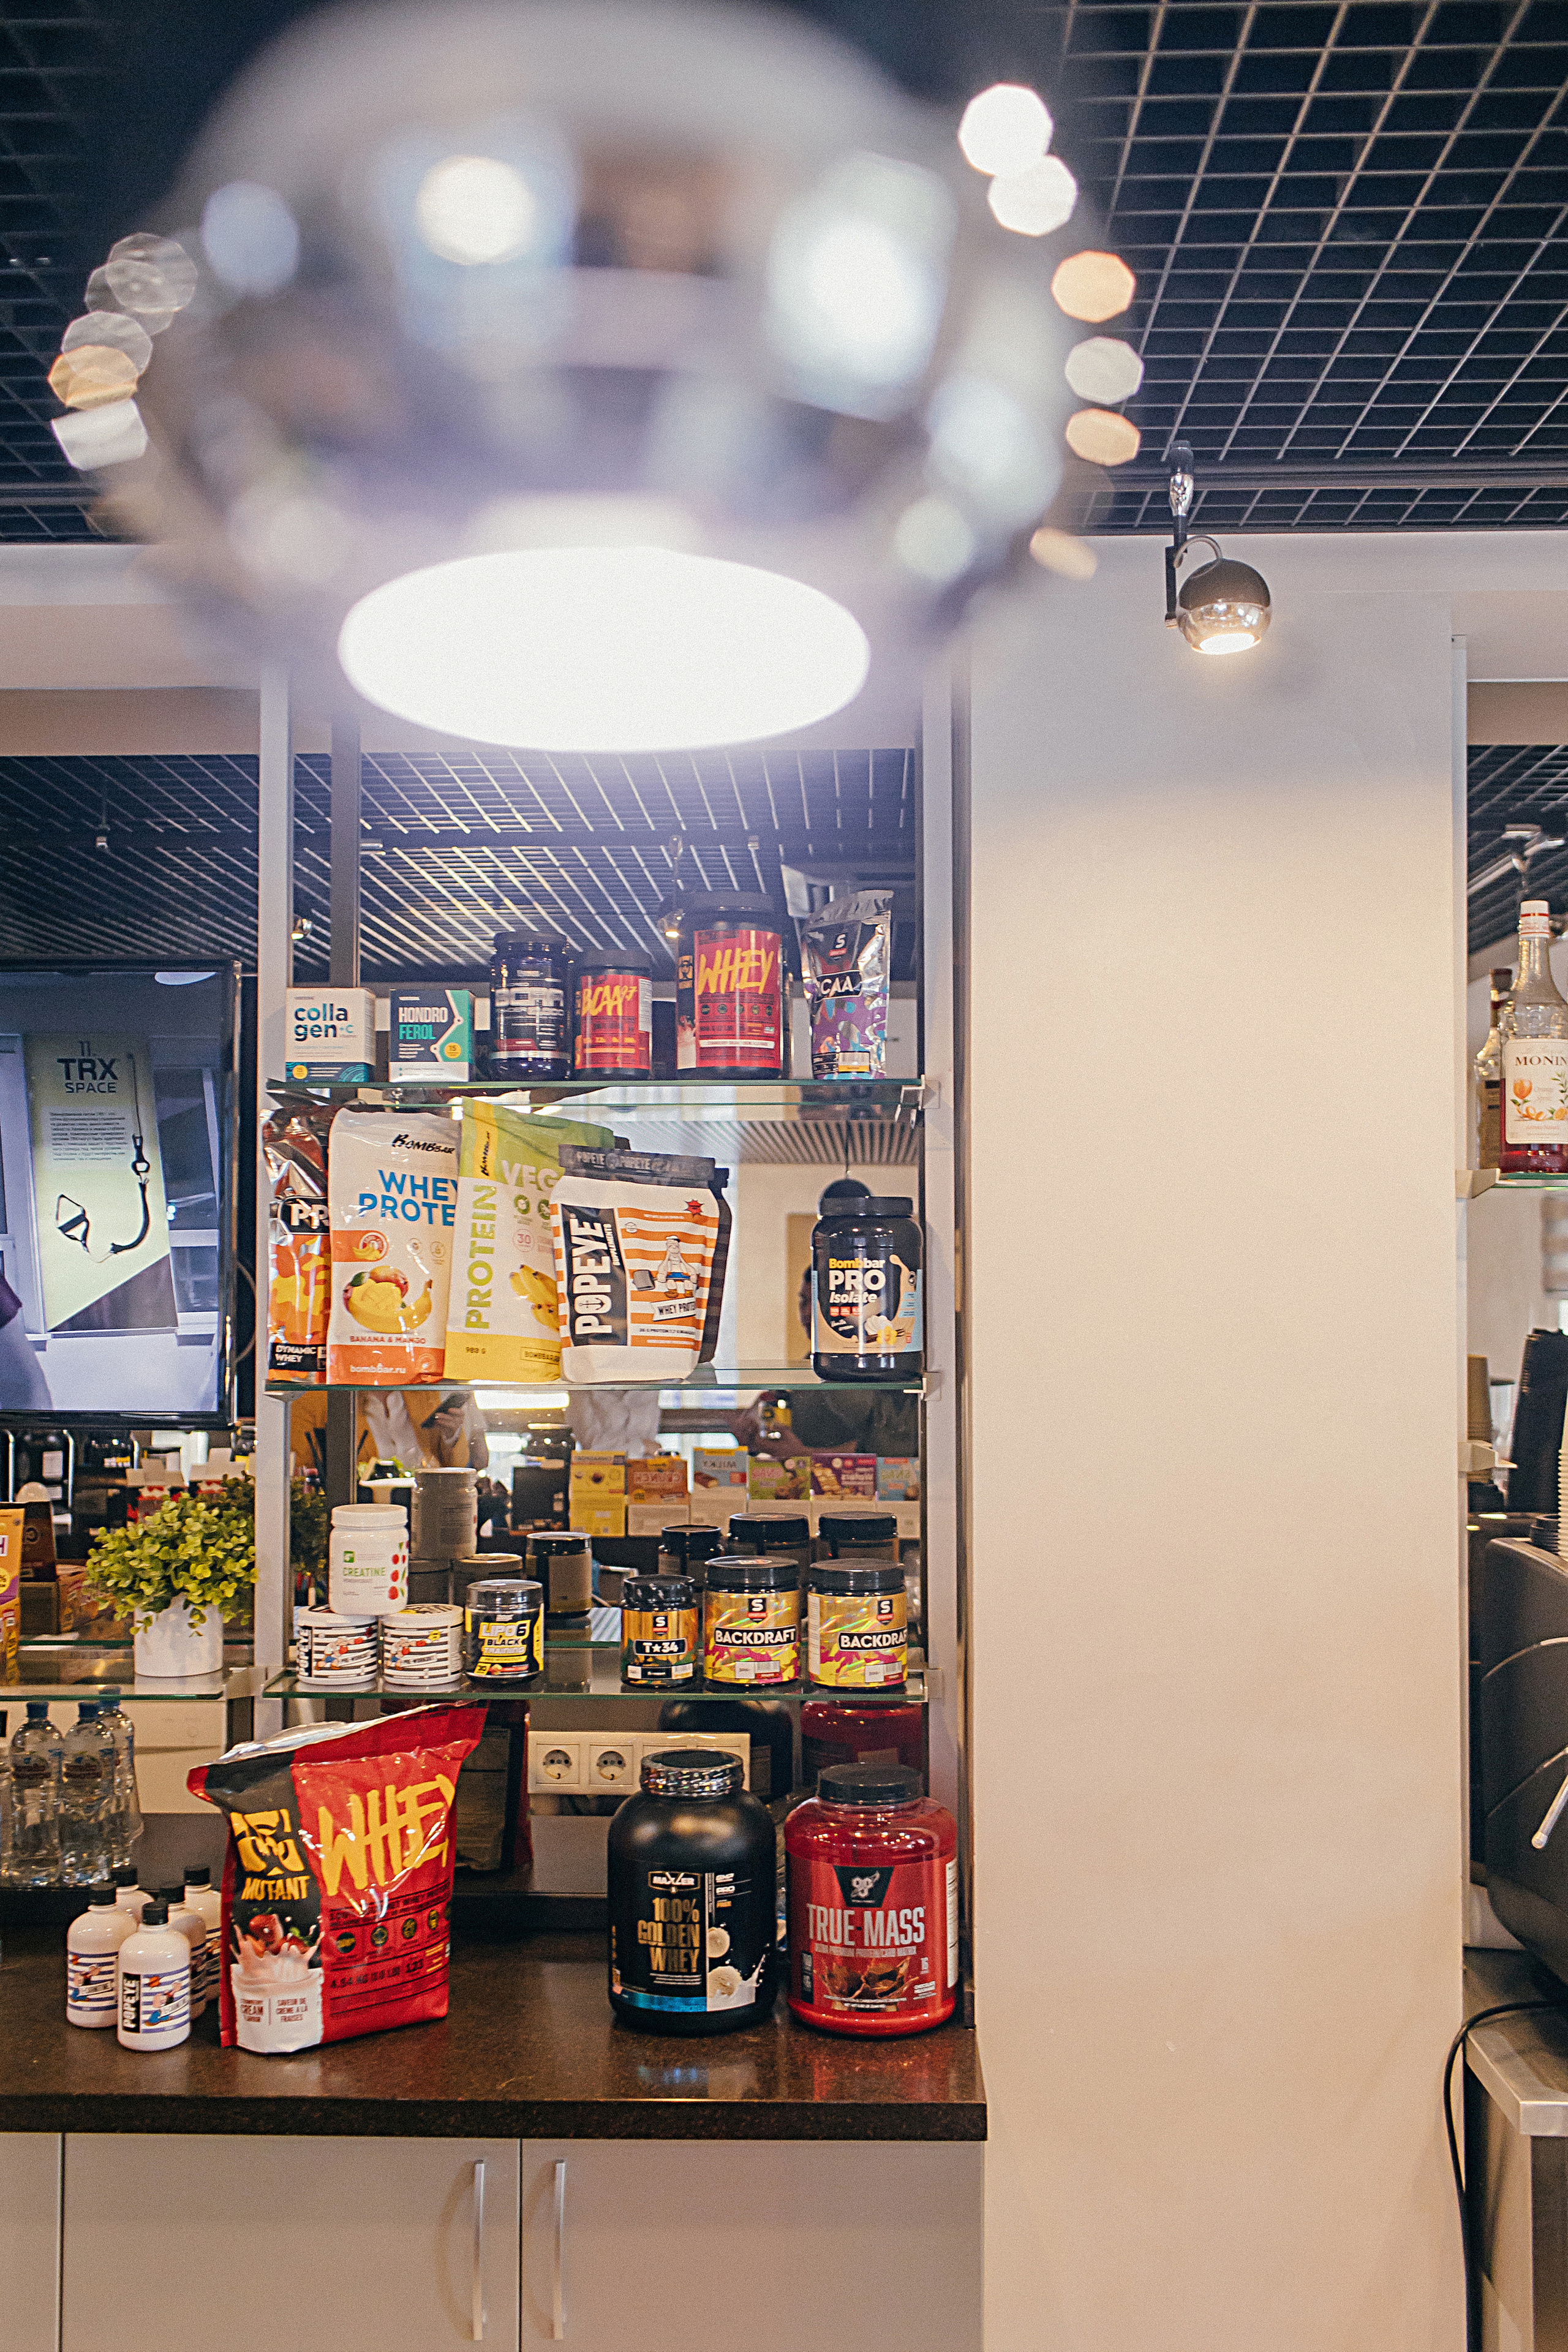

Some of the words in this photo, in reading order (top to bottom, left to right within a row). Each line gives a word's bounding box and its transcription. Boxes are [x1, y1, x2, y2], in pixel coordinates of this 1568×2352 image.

[698, 948, 774, 995] WHEY
[817, 976, 853, 997] CAA
[582, 985, 623, 1016] BCAA
[295, 1003, 348, 1021] colla
[399, 1007, 448, 1023] HONDRO
[295, 1024, 336, 1041] gen
[399, 1024, 436, 1039] FEROL
[56, 1058, 119, 1080] TRX
[65, 1083, 116, 1093] SPACE
[465, 1185, 497, 1329] PROTEIN
[829, 1258, 886, 1269] Bombbar
[570, 1218, 612, 1334] POPEYE
[829, 1270, 886, 1291] PRO
[829, 1291, 878, 1303] Isolate
[275, 1354, 303, 1363] WHEY
[276, 1345, 317, 1355] DYNAMIC
[343, 1567, 386, 1577] CREATINE
[752, 1599, 764, 1612] S
[880, 1600, 891, 1614] S
[655, 1616, 666, 1627] S
[715, 1629, 796, 1645] BACKDRAFT
[241, 1875, 310, 1900] MUTANT
[652, 1898, 700, 1923] 100%
[637, 1920, 700, 1948] GOLDEN
[807, 1903, 856, 1946] TRUE
[864, 1907, 925, 1947] MASS
[649, 1947, 700, 1973] WHEY
[123, 1979, 137, 2029] POPEYE
